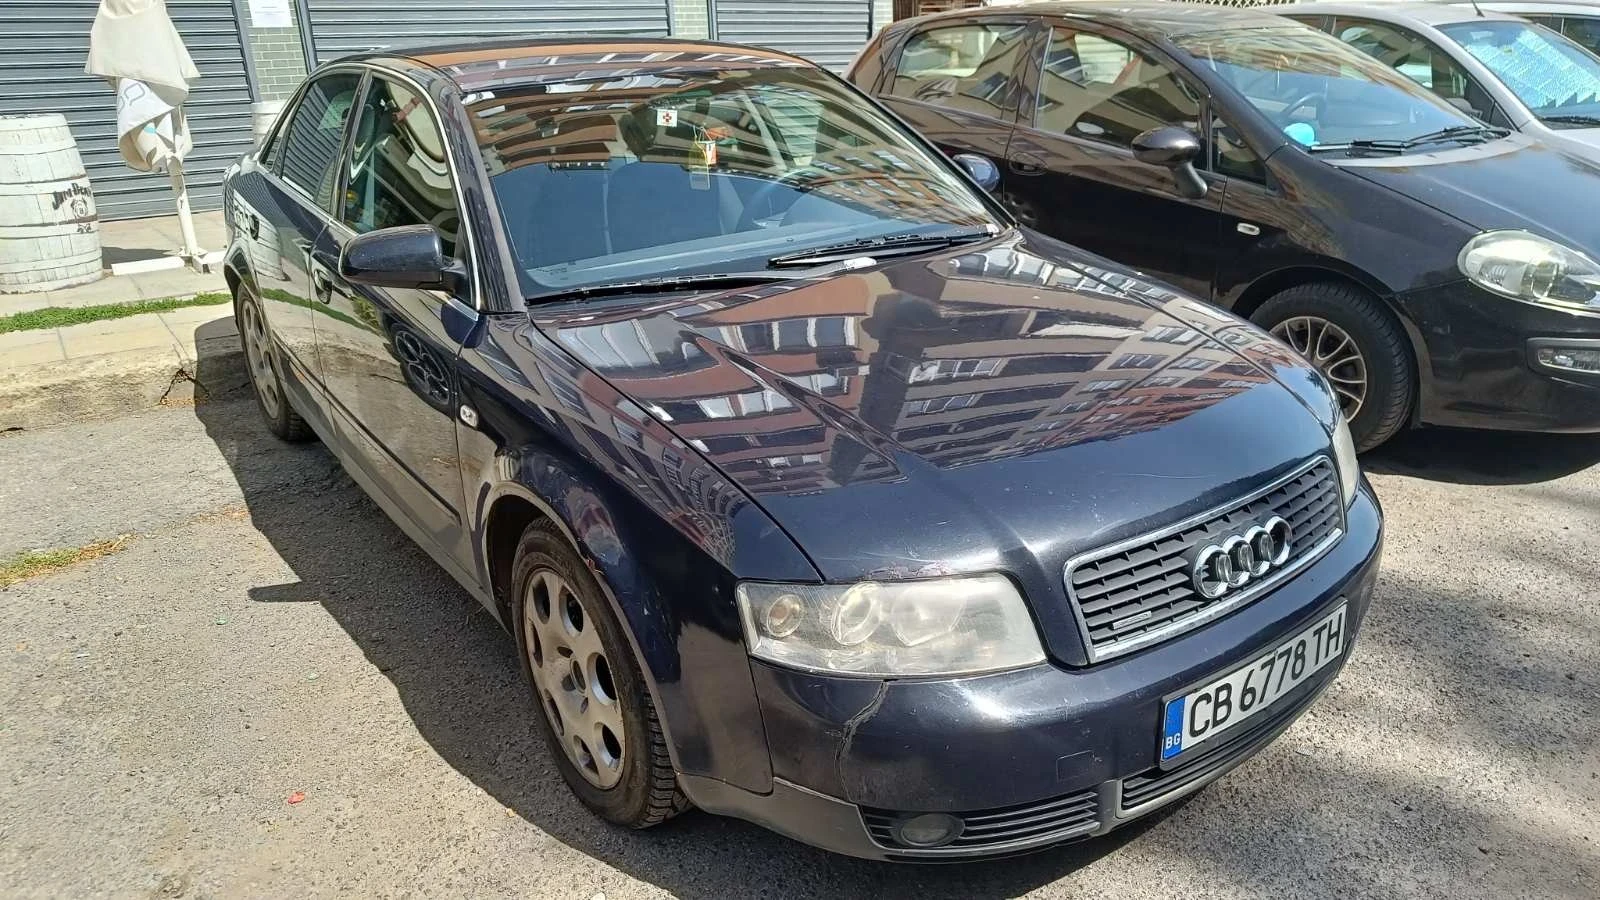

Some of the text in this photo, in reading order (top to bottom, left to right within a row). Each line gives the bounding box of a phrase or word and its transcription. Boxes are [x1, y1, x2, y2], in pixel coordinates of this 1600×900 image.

[1189, 612, 1342, 738] CB 6778 TH
[1166, 733, 1181, 749] BG
